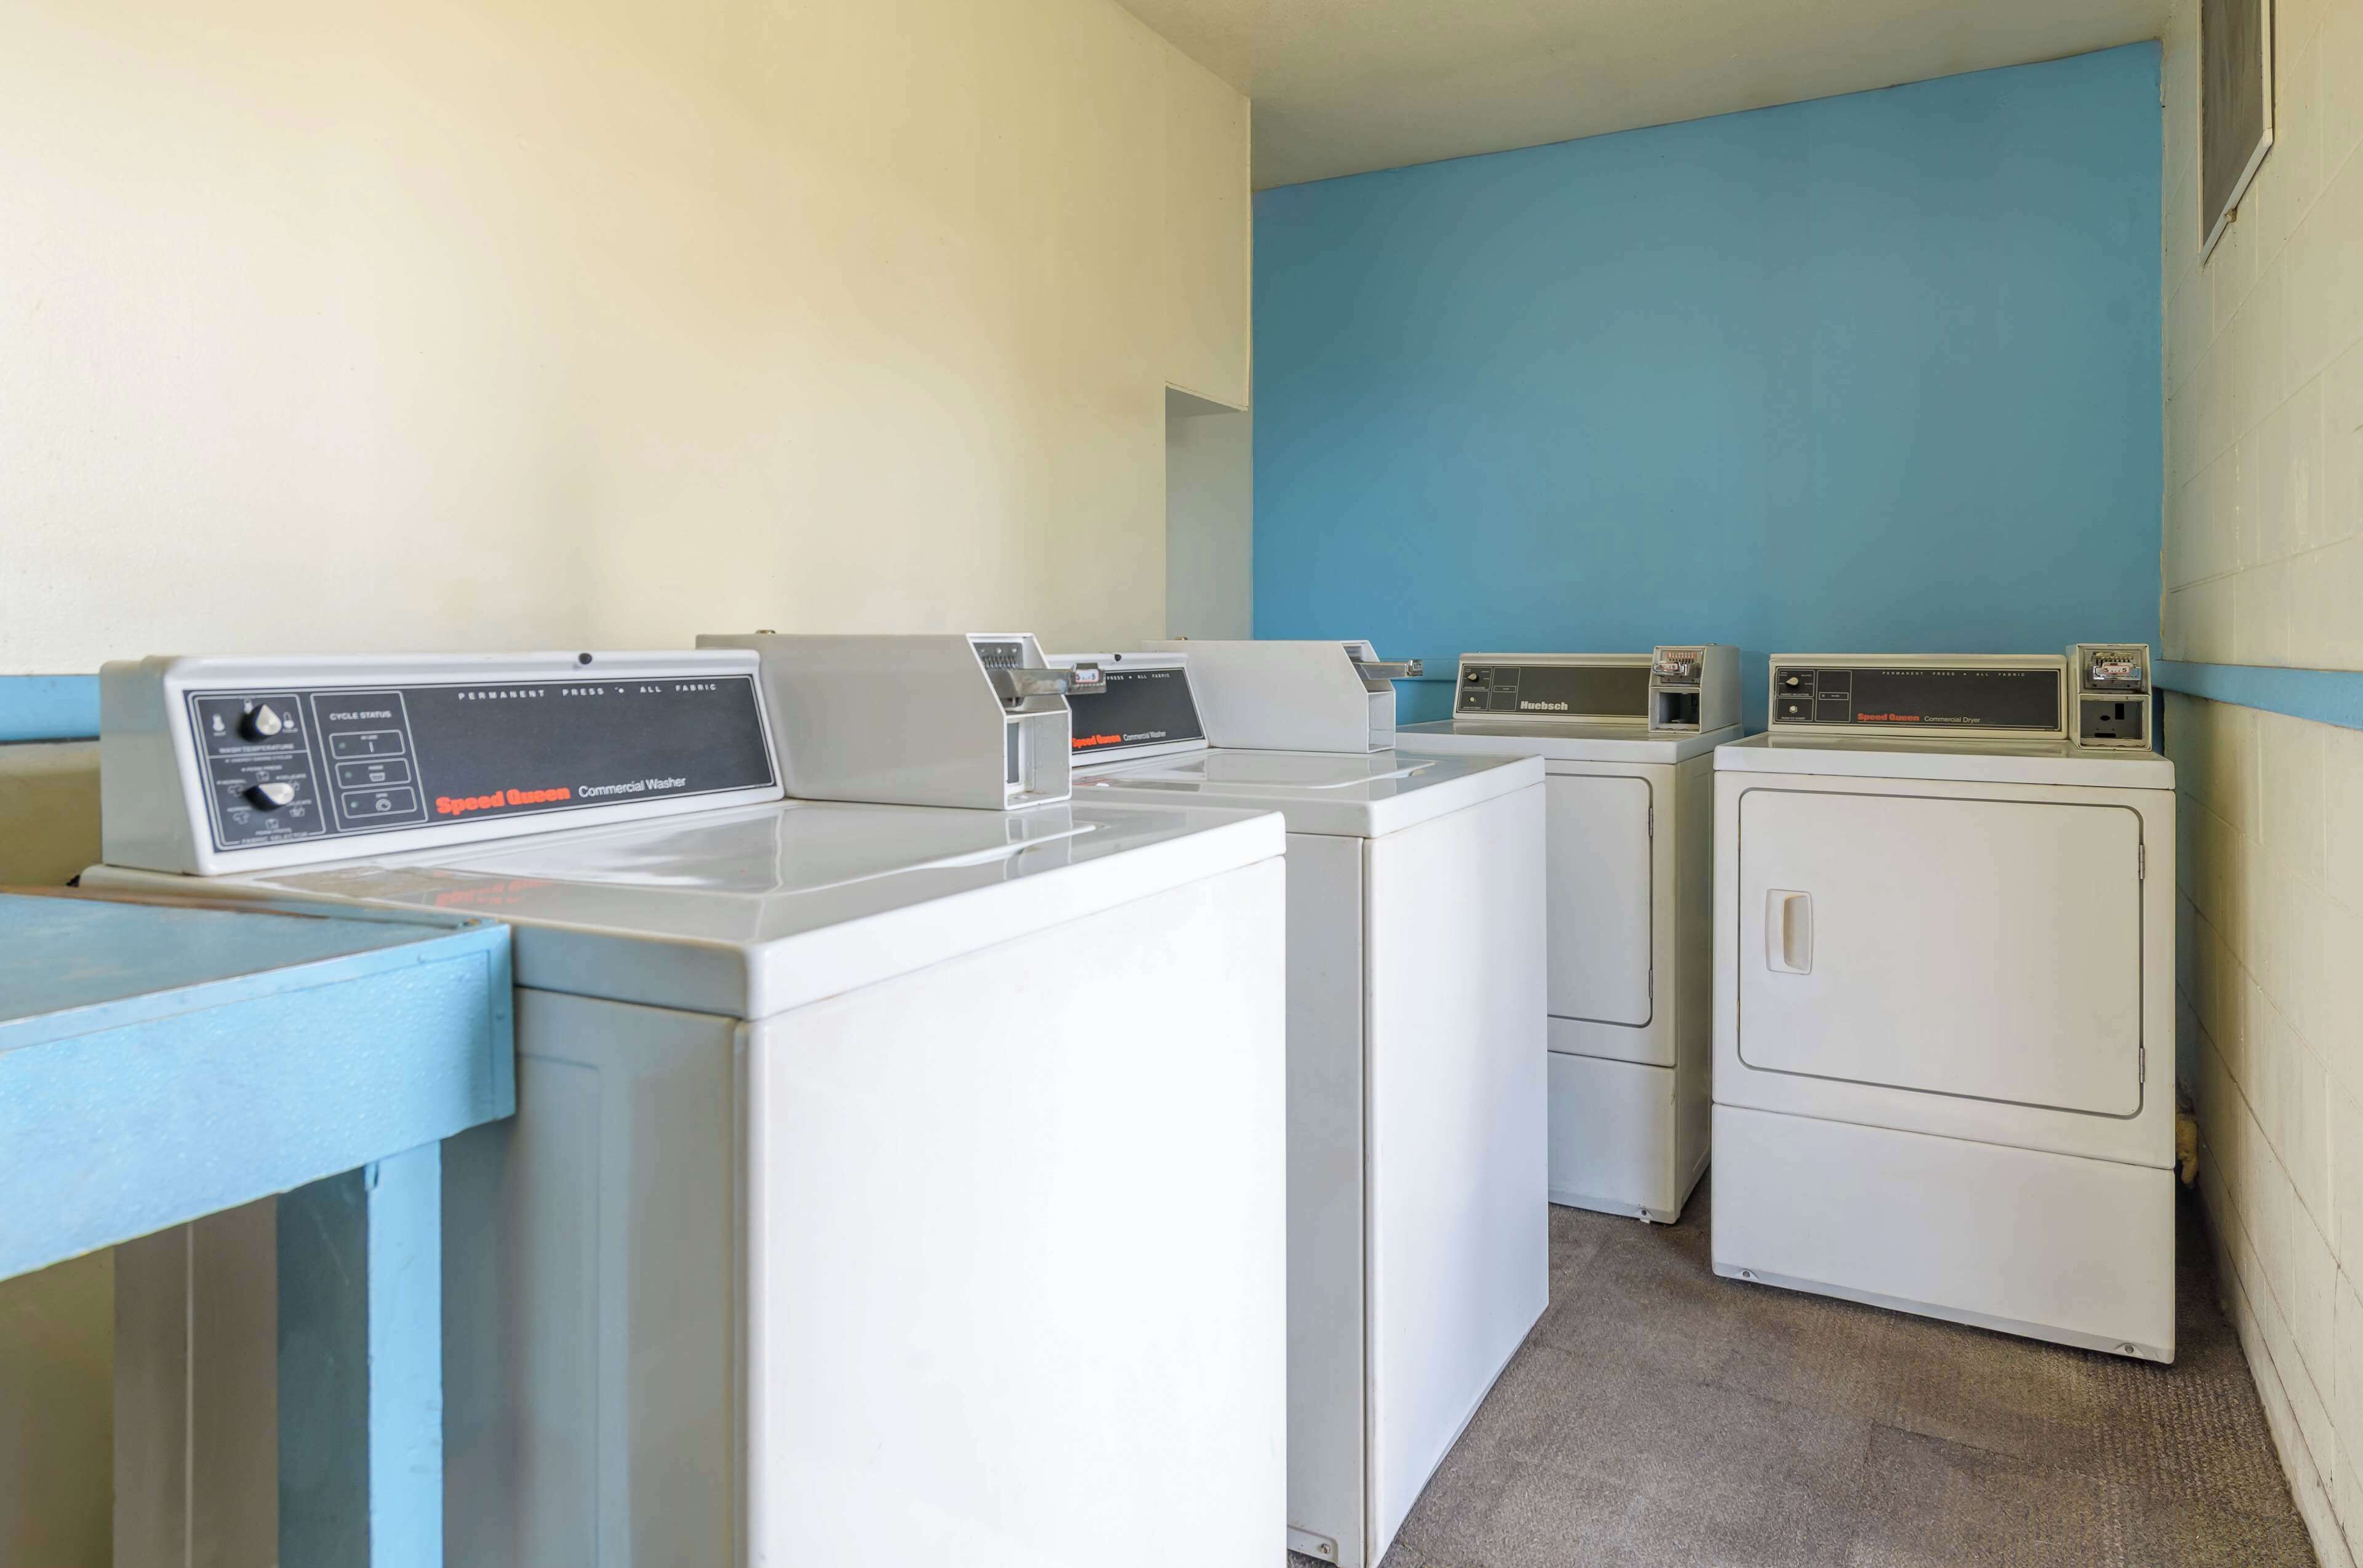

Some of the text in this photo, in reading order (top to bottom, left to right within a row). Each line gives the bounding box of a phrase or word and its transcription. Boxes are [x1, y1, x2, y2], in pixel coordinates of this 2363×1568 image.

[458, 683, 716, 700] PERMANENT PRESS ALL FABRIC
[1521, 700, 1568, 711] Huebsch
[329, 710, 392, 721] CYCLE STATUS
[1857, 713, 1888, 721] Speed
[1889, 713, 1921, 722] Queen
[1073, 735, 1097, 749] Speed
[1097, 734, 1122, 745] Queen
[436, 776, 687, 815] Speed Queen Commercial Washer
